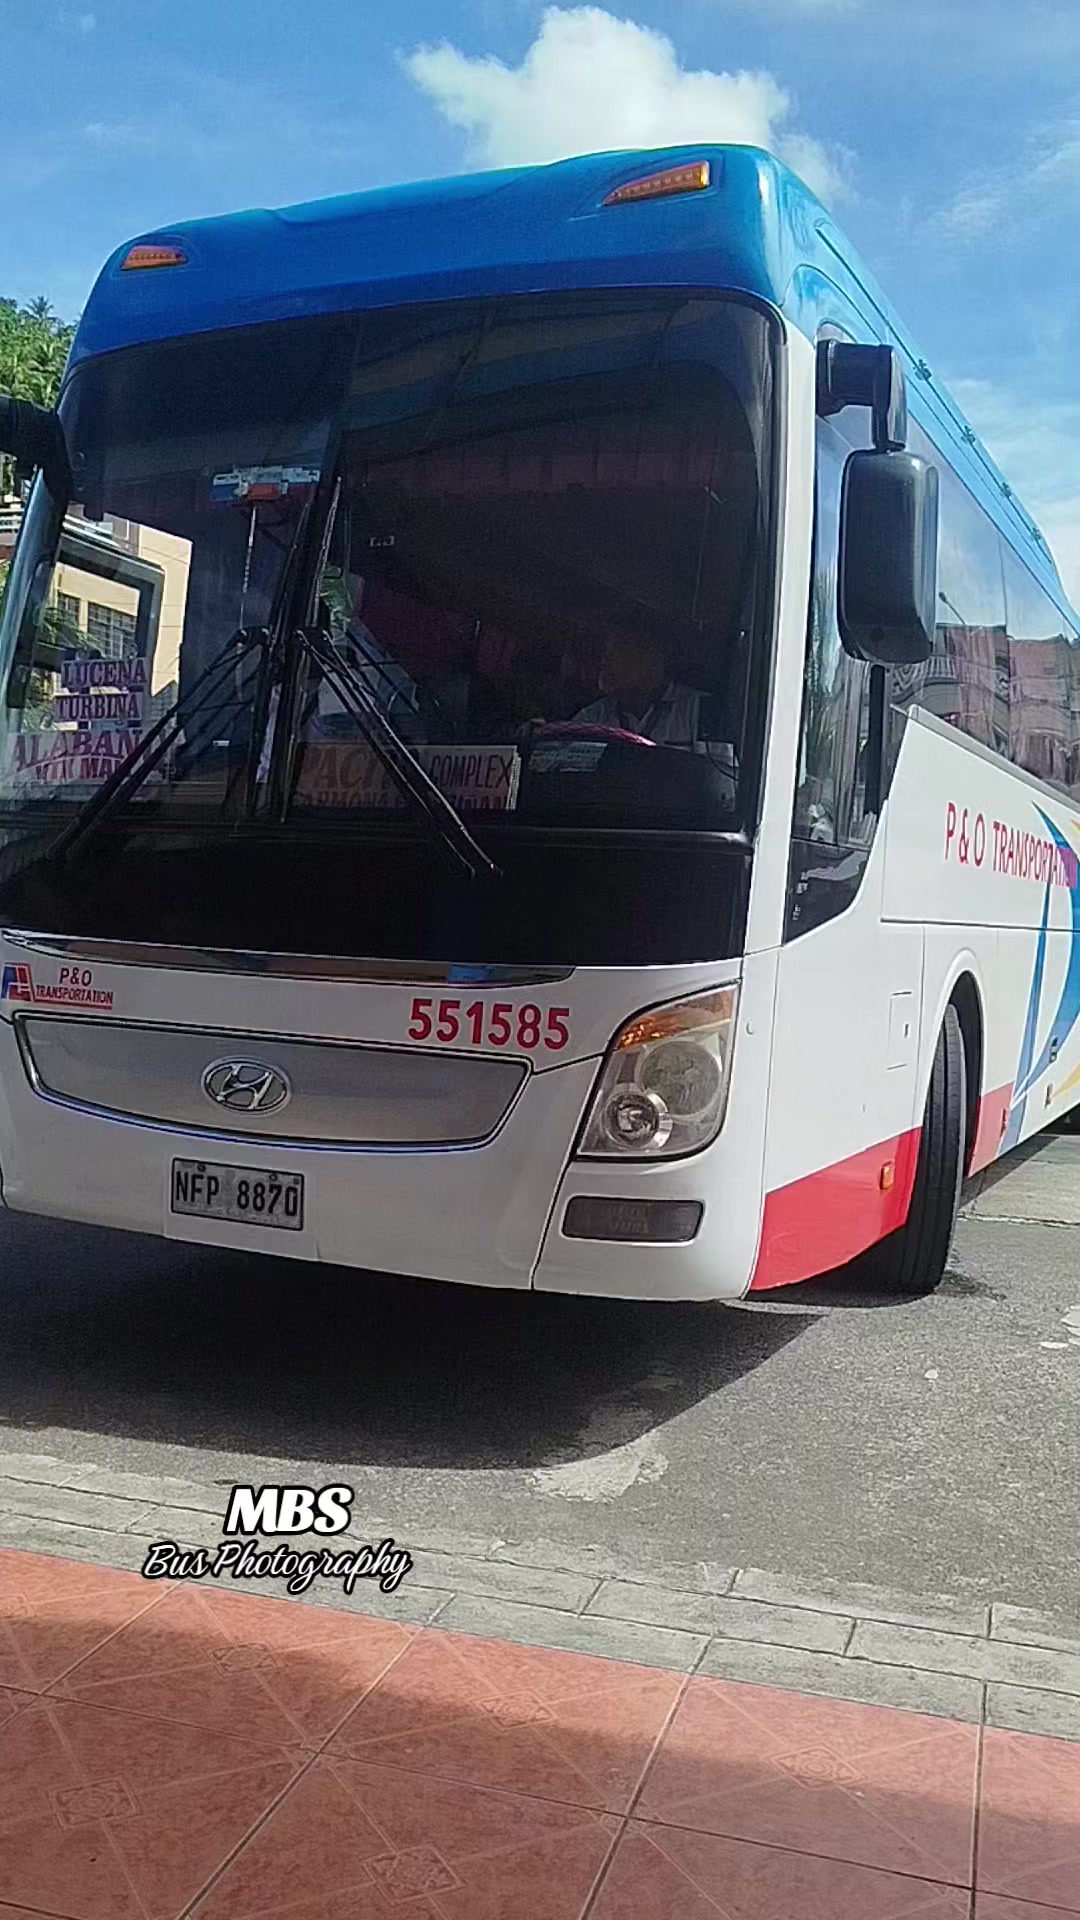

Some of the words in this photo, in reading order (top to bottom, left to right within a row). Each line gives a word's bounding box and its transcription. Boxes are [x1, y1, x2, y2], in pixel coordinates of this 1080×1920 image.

[63, 659, 147, 686] LUCENA
[57, 693, 140, 719] TURBINA
[12, 729, 143, 770] ALABAN
[431, 754, 513, 788] COMPLEX
[59, 966, 92, 986] P&O
[36, 984, 113, 1004] TRANSPORTATION
[408, 998, 570, 1051] 551585
[176, 1170, 220, 1205] NFP
[236, 1180, 298, 1217] 8870
